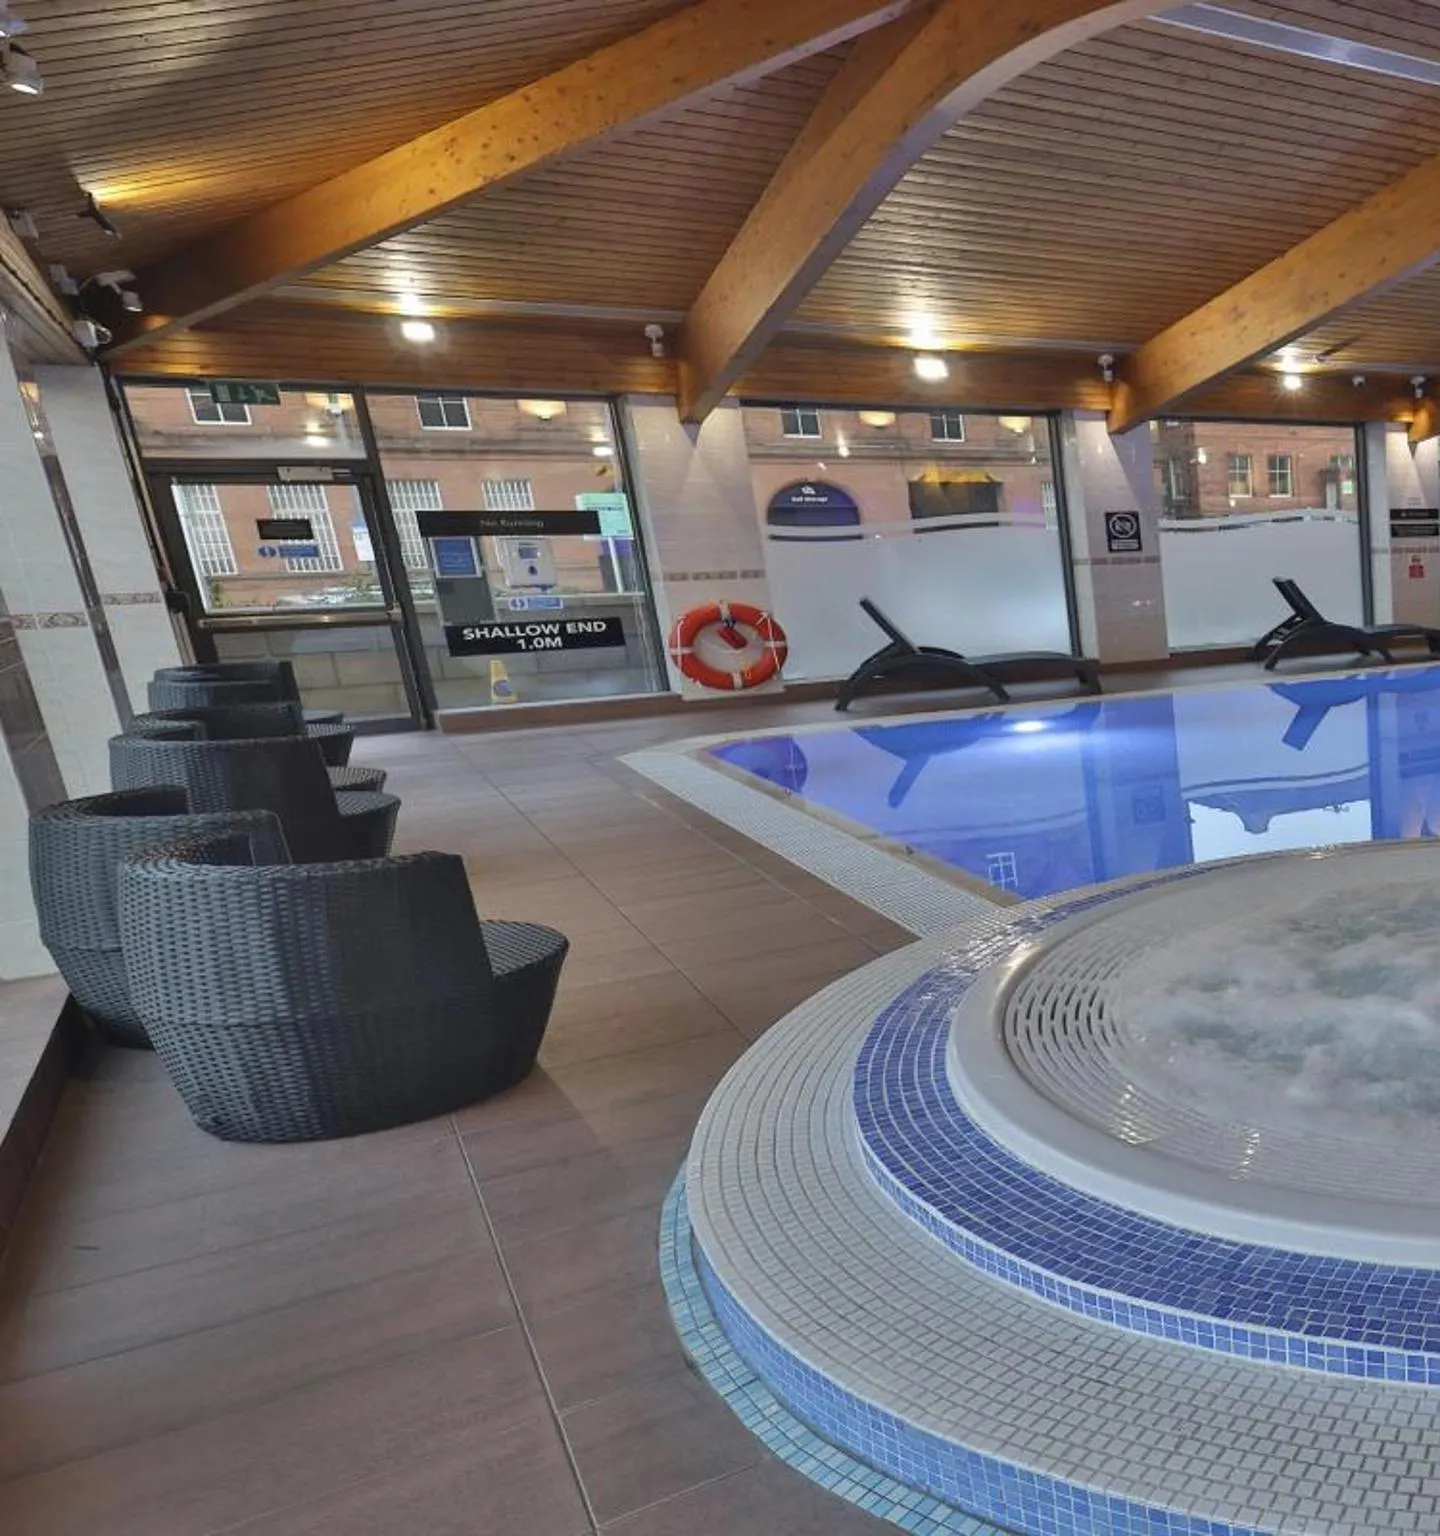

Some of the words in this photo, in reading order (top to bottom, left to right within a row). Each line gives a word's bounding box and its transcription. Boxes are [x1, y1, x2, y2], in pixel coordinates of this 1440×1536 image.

[462, 621, 561, 641] SHALLOW
[566, 620, 607, 634] END
[516, 636, 563, 650] 1.0M
